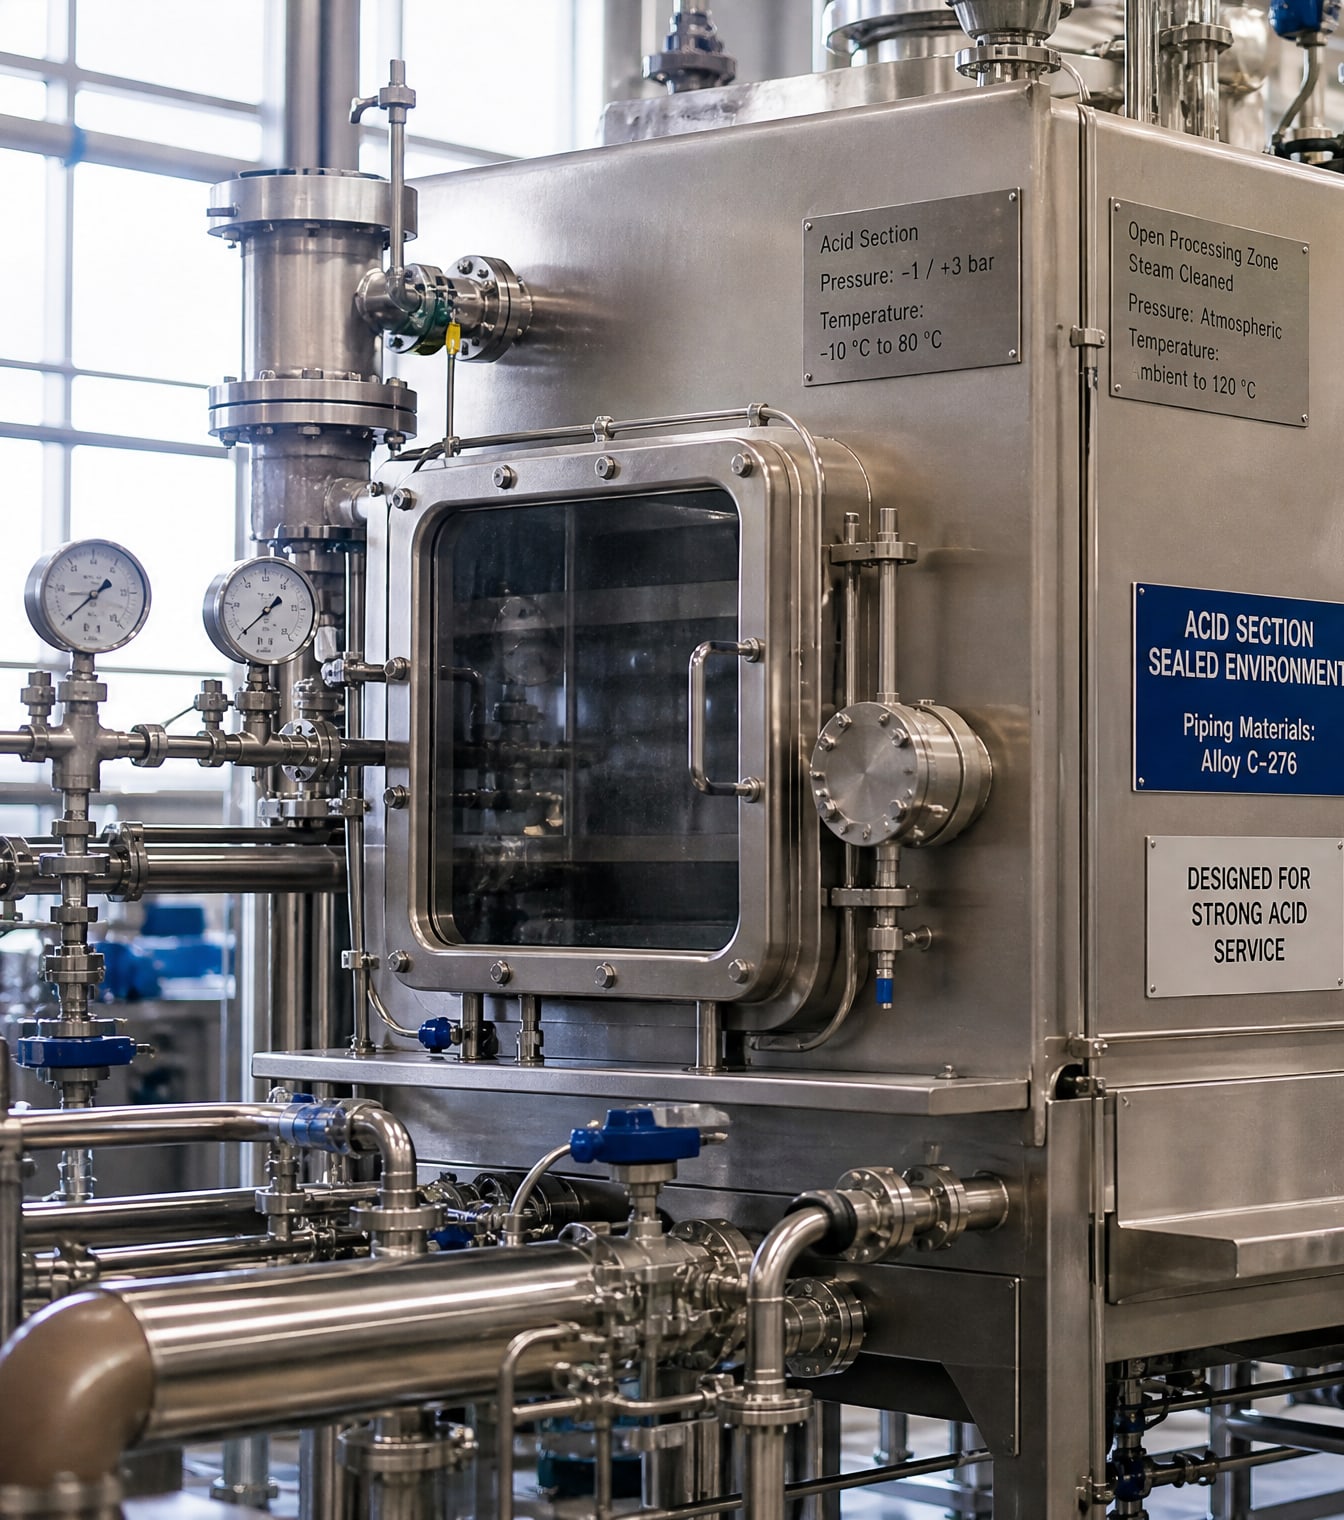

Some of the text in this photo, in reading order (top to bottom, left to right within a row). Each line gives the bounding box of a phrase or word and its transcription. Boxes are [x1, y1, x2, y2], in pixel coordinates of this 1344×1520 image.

[820, 225, 918, 254] Acid Section
[1129, 221, 1278, 270] Open Processing Zone
[821, 271, 893, 292] Pressure:
[926, 258, 933, 280] /
[941, 256, 961, 275] +3
[969, 255, 995, 273] bar
[1129, 253, 1233, 291] Steam Cleaned
[820, 305, 924, 331] Temperature:
[1129, 293, 1282, 339] Pressure: Atmospheric
[852, 338, 870, 356] °C
[877, 338, 892, 354] to
[899, 333, 917, 352] 80
[924, 330, 942, 348] °C
[1129, 328, 1218, 360] Temperature:
[1131, 362, 1255, 399] mbient to 120 °C
[1185, 610, 1313, 647] ACID SECTION
[1149, 647, 1218, 678] SEALED
[1184, 713, 1314, 743] Piping Materials:
[1202, 749, 1297, 778] Alloy C-276
[1188, 867, 1310, 890] DESIGNED FOR
[1192, 901, 1307, 926] STRONG ACID
[1215, 938, 1284, 963] SERVICE
